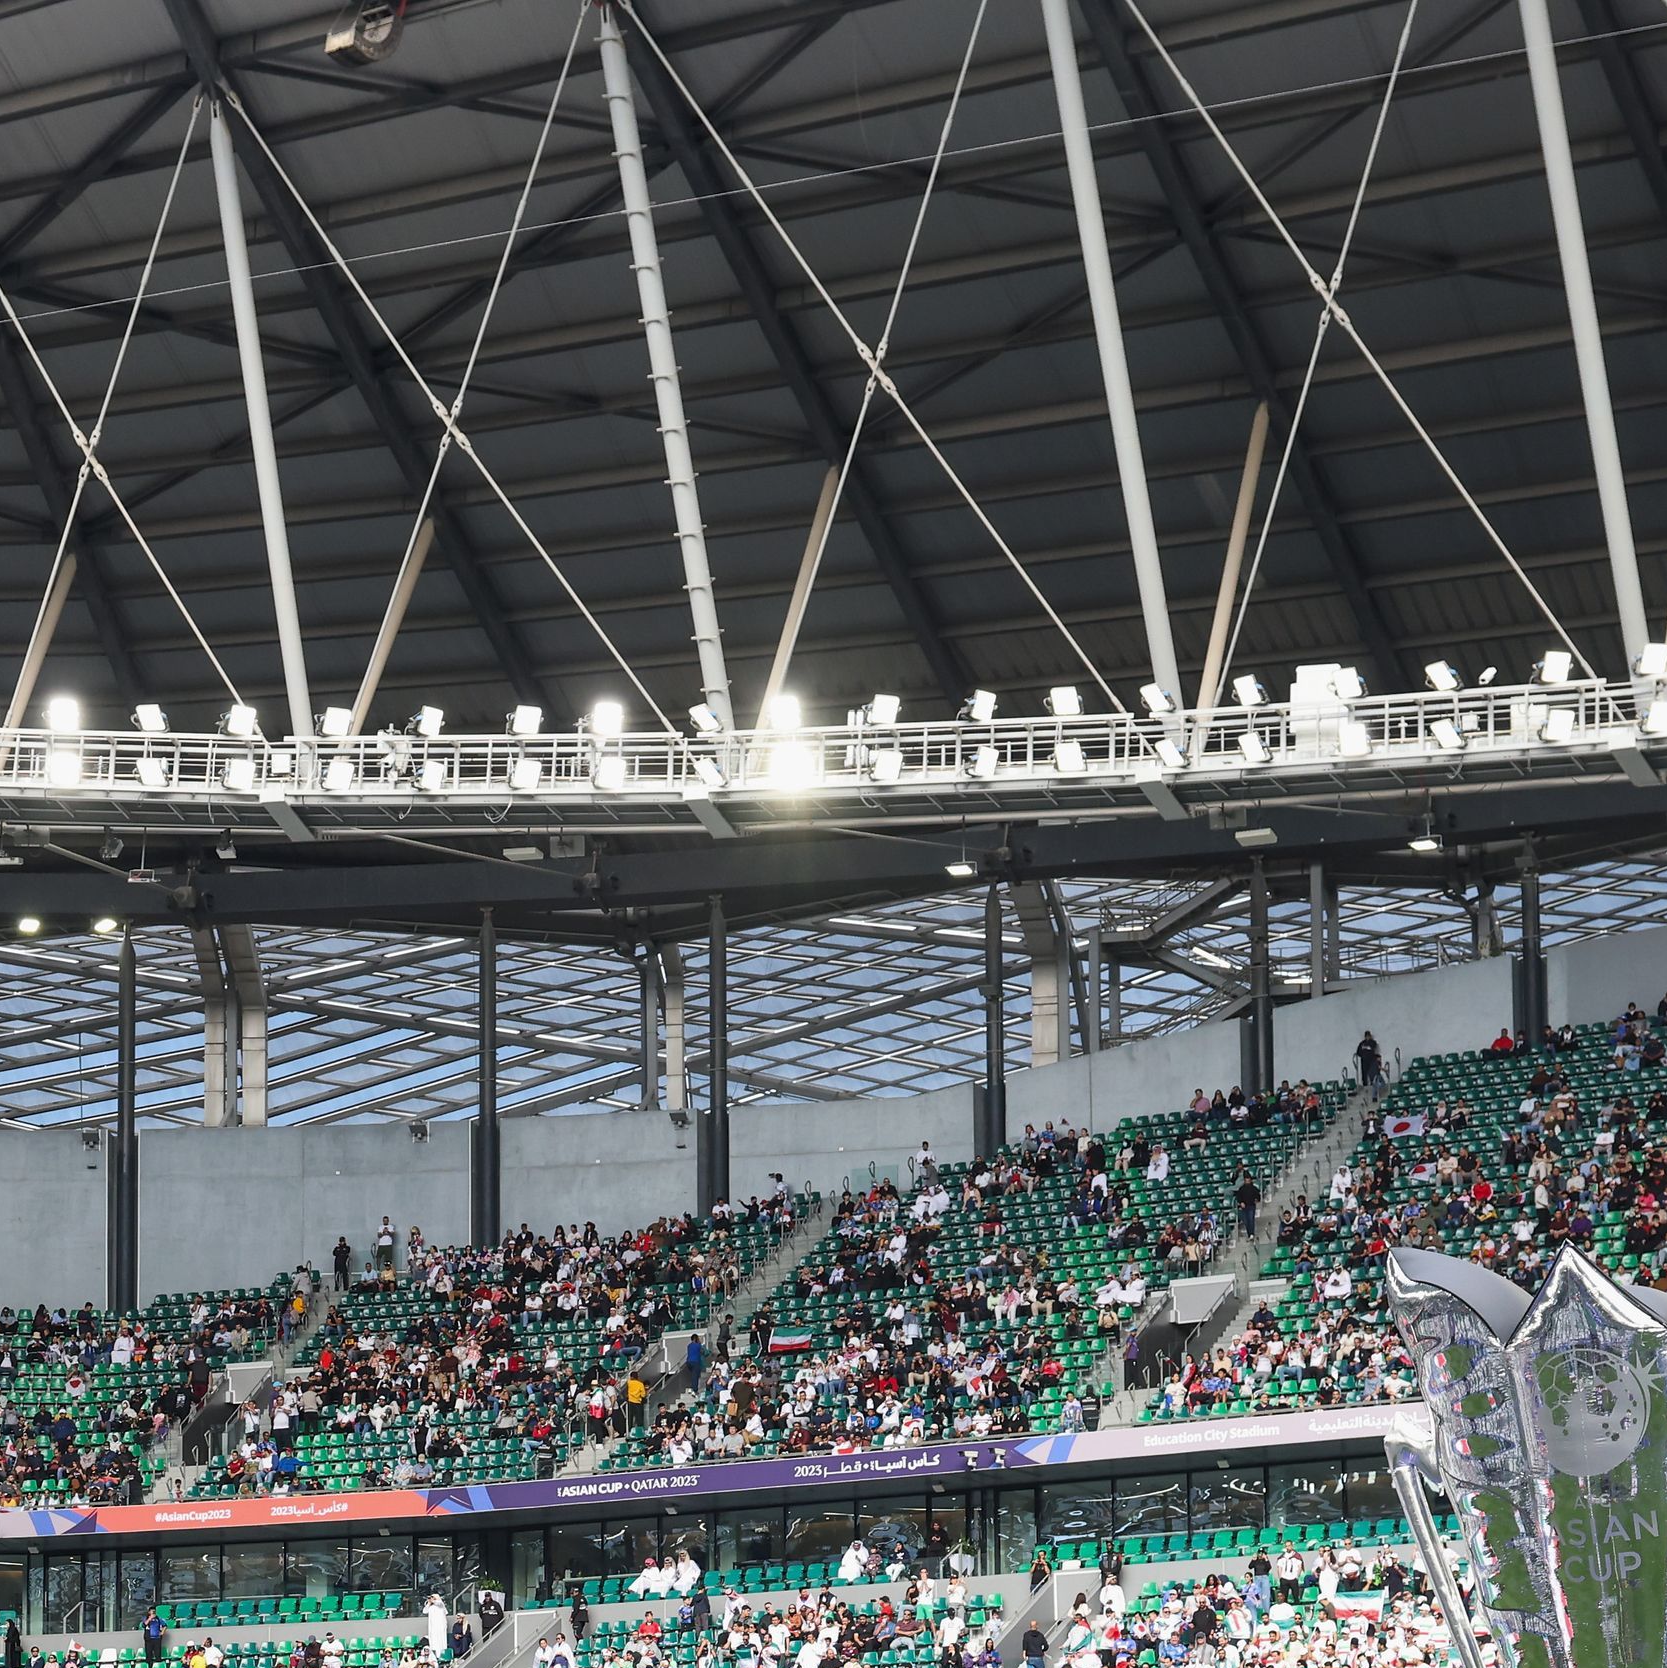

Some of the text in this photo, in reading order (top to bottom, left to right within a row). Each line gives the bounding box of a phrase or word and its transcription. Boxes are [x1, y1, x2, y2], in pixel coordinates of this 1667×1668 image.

[1143, 1425, 1280, 1447] Education City Stadium
[794, 1465, 823, 1478] 2023
[561, 1484, 597, 1497] ASIAN
[598, 1482, 623, 1495] CUP
[631, 1477, 669, 1493] QATAR
[155, 1509, 232, 1523] #AsianCup2023
[1554, 1510, 1660, 1549] ASIAN
[1564, 1551, 1643, 1582] CUP
